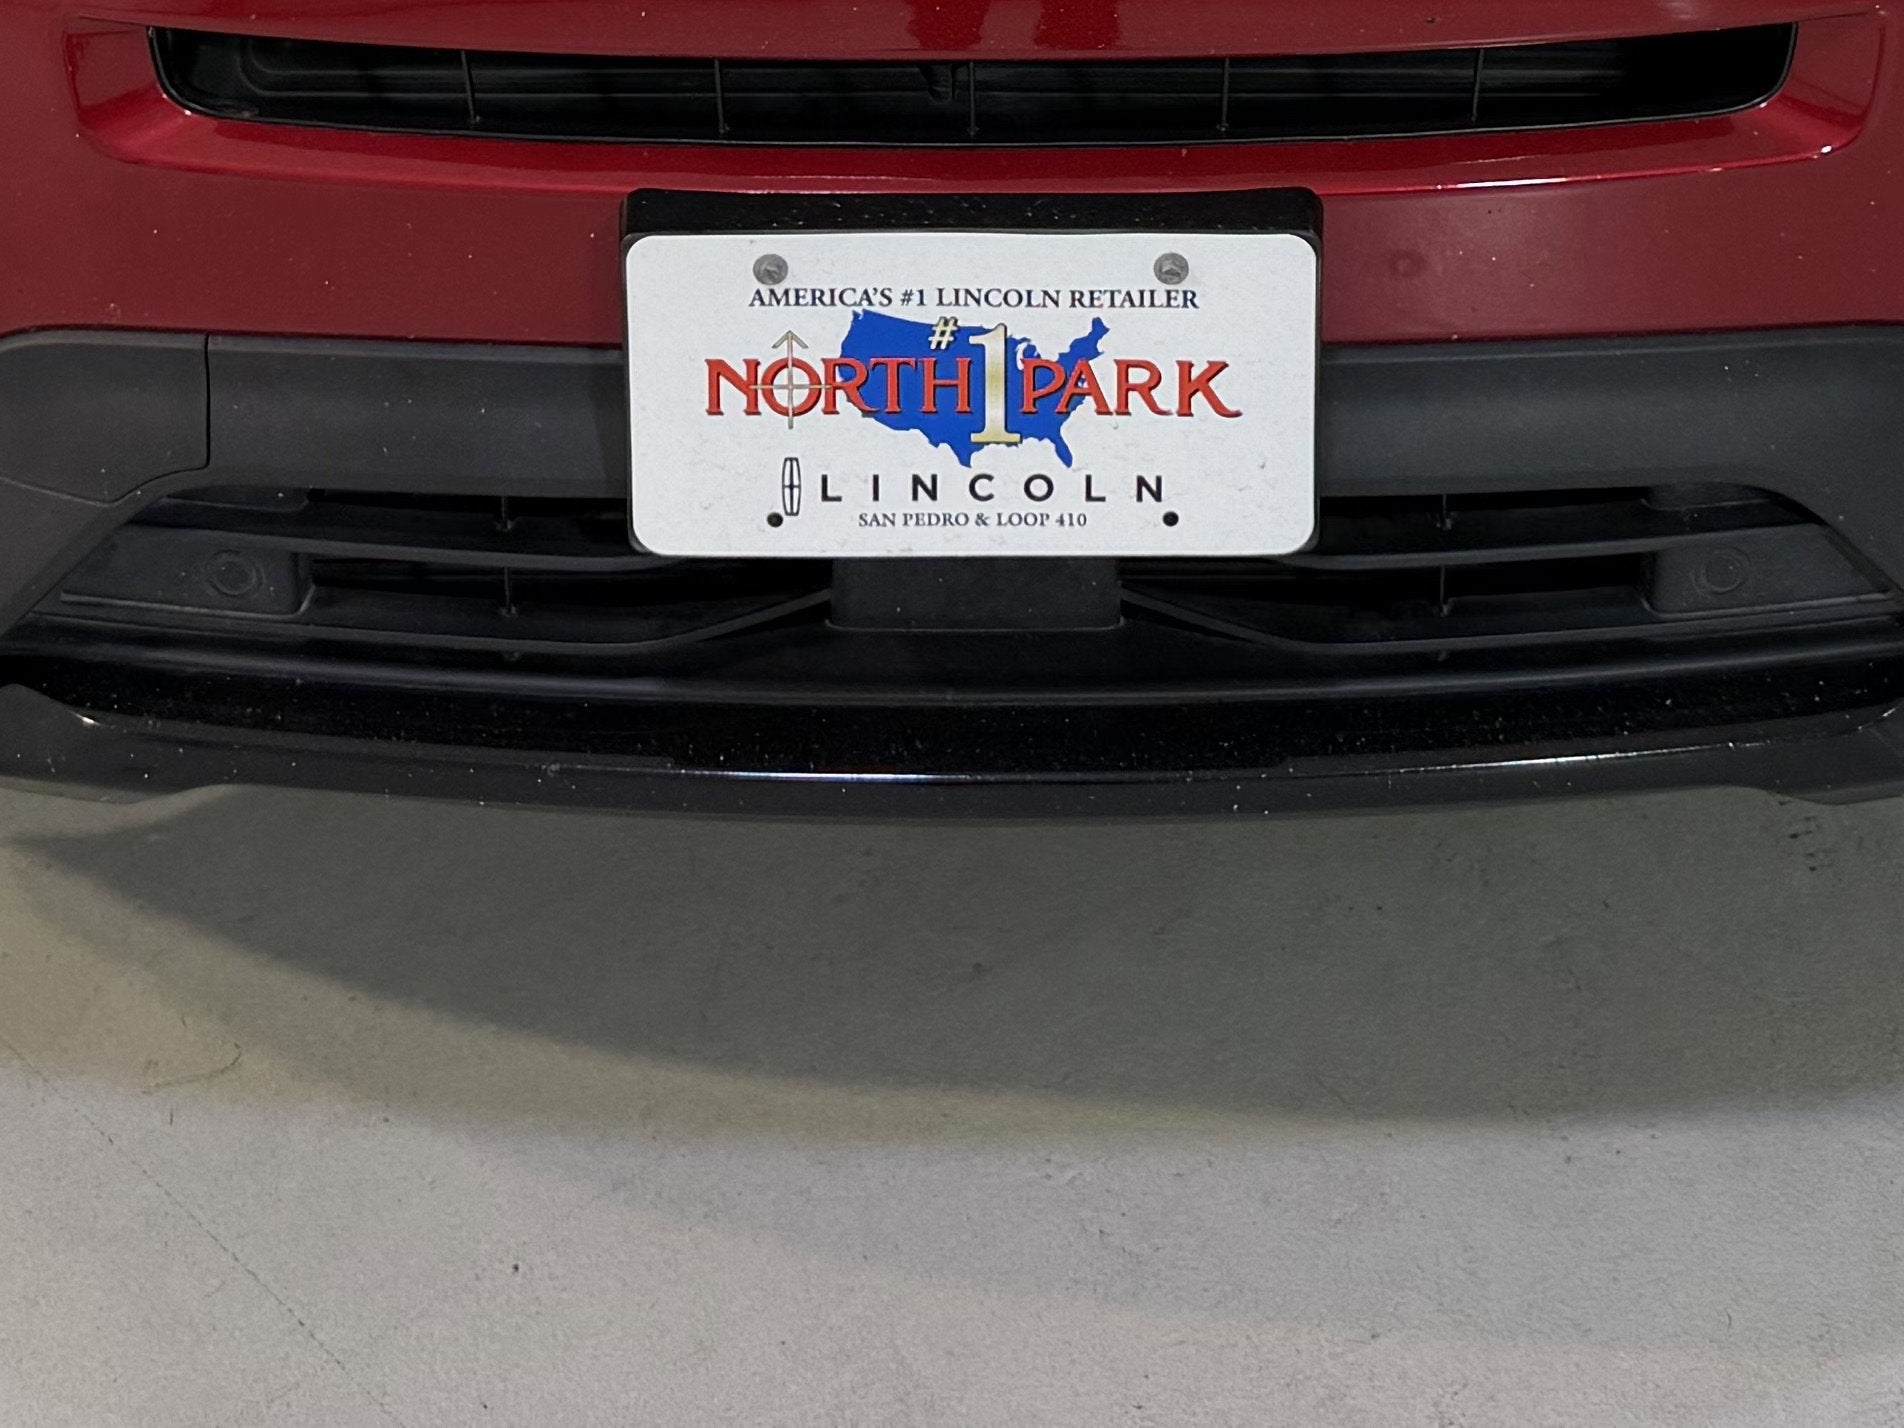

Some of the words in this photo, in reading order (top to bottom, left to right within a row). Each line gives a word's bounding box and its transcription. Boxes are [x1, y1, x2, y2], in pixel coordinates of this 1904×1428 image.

[748, 287, 893, 308] AMERICA'S
[901, 287, 927, 307] #1
[935, 288, 1060, 308] LINCOLN
[1068, 289, 1200, 309] RETAILER
[705, 357, 973, 417] NORTH
[1020, 358, 1243, 418] PARK
[821, 473, 1163, 503] LINCOLN
[858, 511, 897, 527] SAN
[902, 511, 969, 527] PEDRO
[974, 511, 991, 527] &
[996, 512, 1050, 527] LOOP
[1055, 512, 1087, 528] 410
